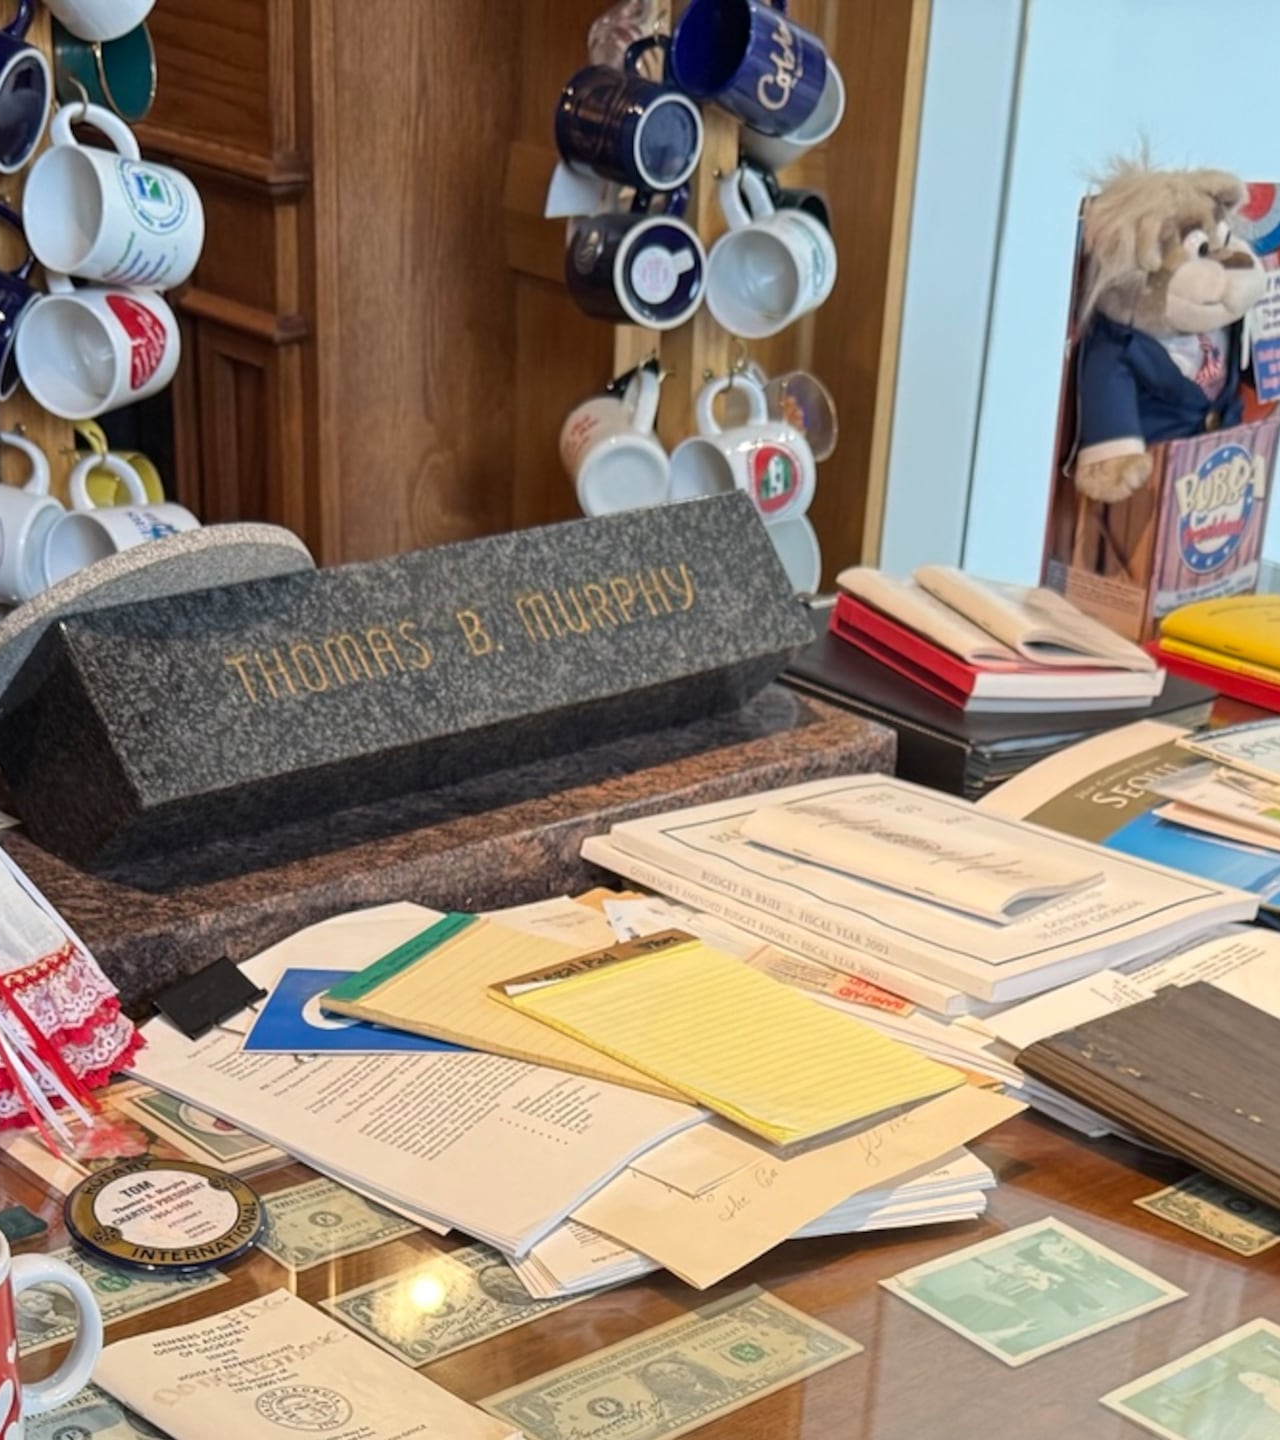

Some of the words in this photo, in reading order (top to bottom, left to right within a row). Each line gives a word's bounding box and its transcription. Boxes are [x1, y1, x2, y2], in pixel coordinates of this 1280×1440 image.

[1175, 453, 1266, 517] BUBBA
[225, 620, 434, 701] THOMAS
[457, 607, 506, 657] B.
[516, 562, 696, 644] MURPHY
[701, 870, 738, 893] BUDGET
[740, 887, 754, 899] IN
[755, 892, 782, 912] BRIEF
[799, 911, 832, 933] FISCAL
[835, 925, 864, 946] YEAR
[723, 904, 757, 928] BUDGET
[759, 919, 793, 943] REPORT
[800, 938, 829, 960] FISCAL
[830, 951, 857, 969] YEAR
[580, 951, 618, 969] Pad
[82, 1160, 152, 1195] ROTARY
[120, 1180, 155, 1198] TOM
[112, 1206, 157, 1227] CHARTER
[158, 1182, 207, 1207] PRESIDENT
[113, 1198, 145, 1214] Thomas
[156, 1179, 188, 1196] Murphy
[131, 1201, 258, 1262] INTERNATIONAL
[152, 1333, 201, 1348] MEMBERS
[201, 1329, 215, 1337] OF
[153, 1340, 203, 1356] GENERAL
[203, 1325, 251, 1346] ASSEMBLY
[178, 1350, 194, 1358] OF
[197, 1337, 244, 1352] GEORGIA
